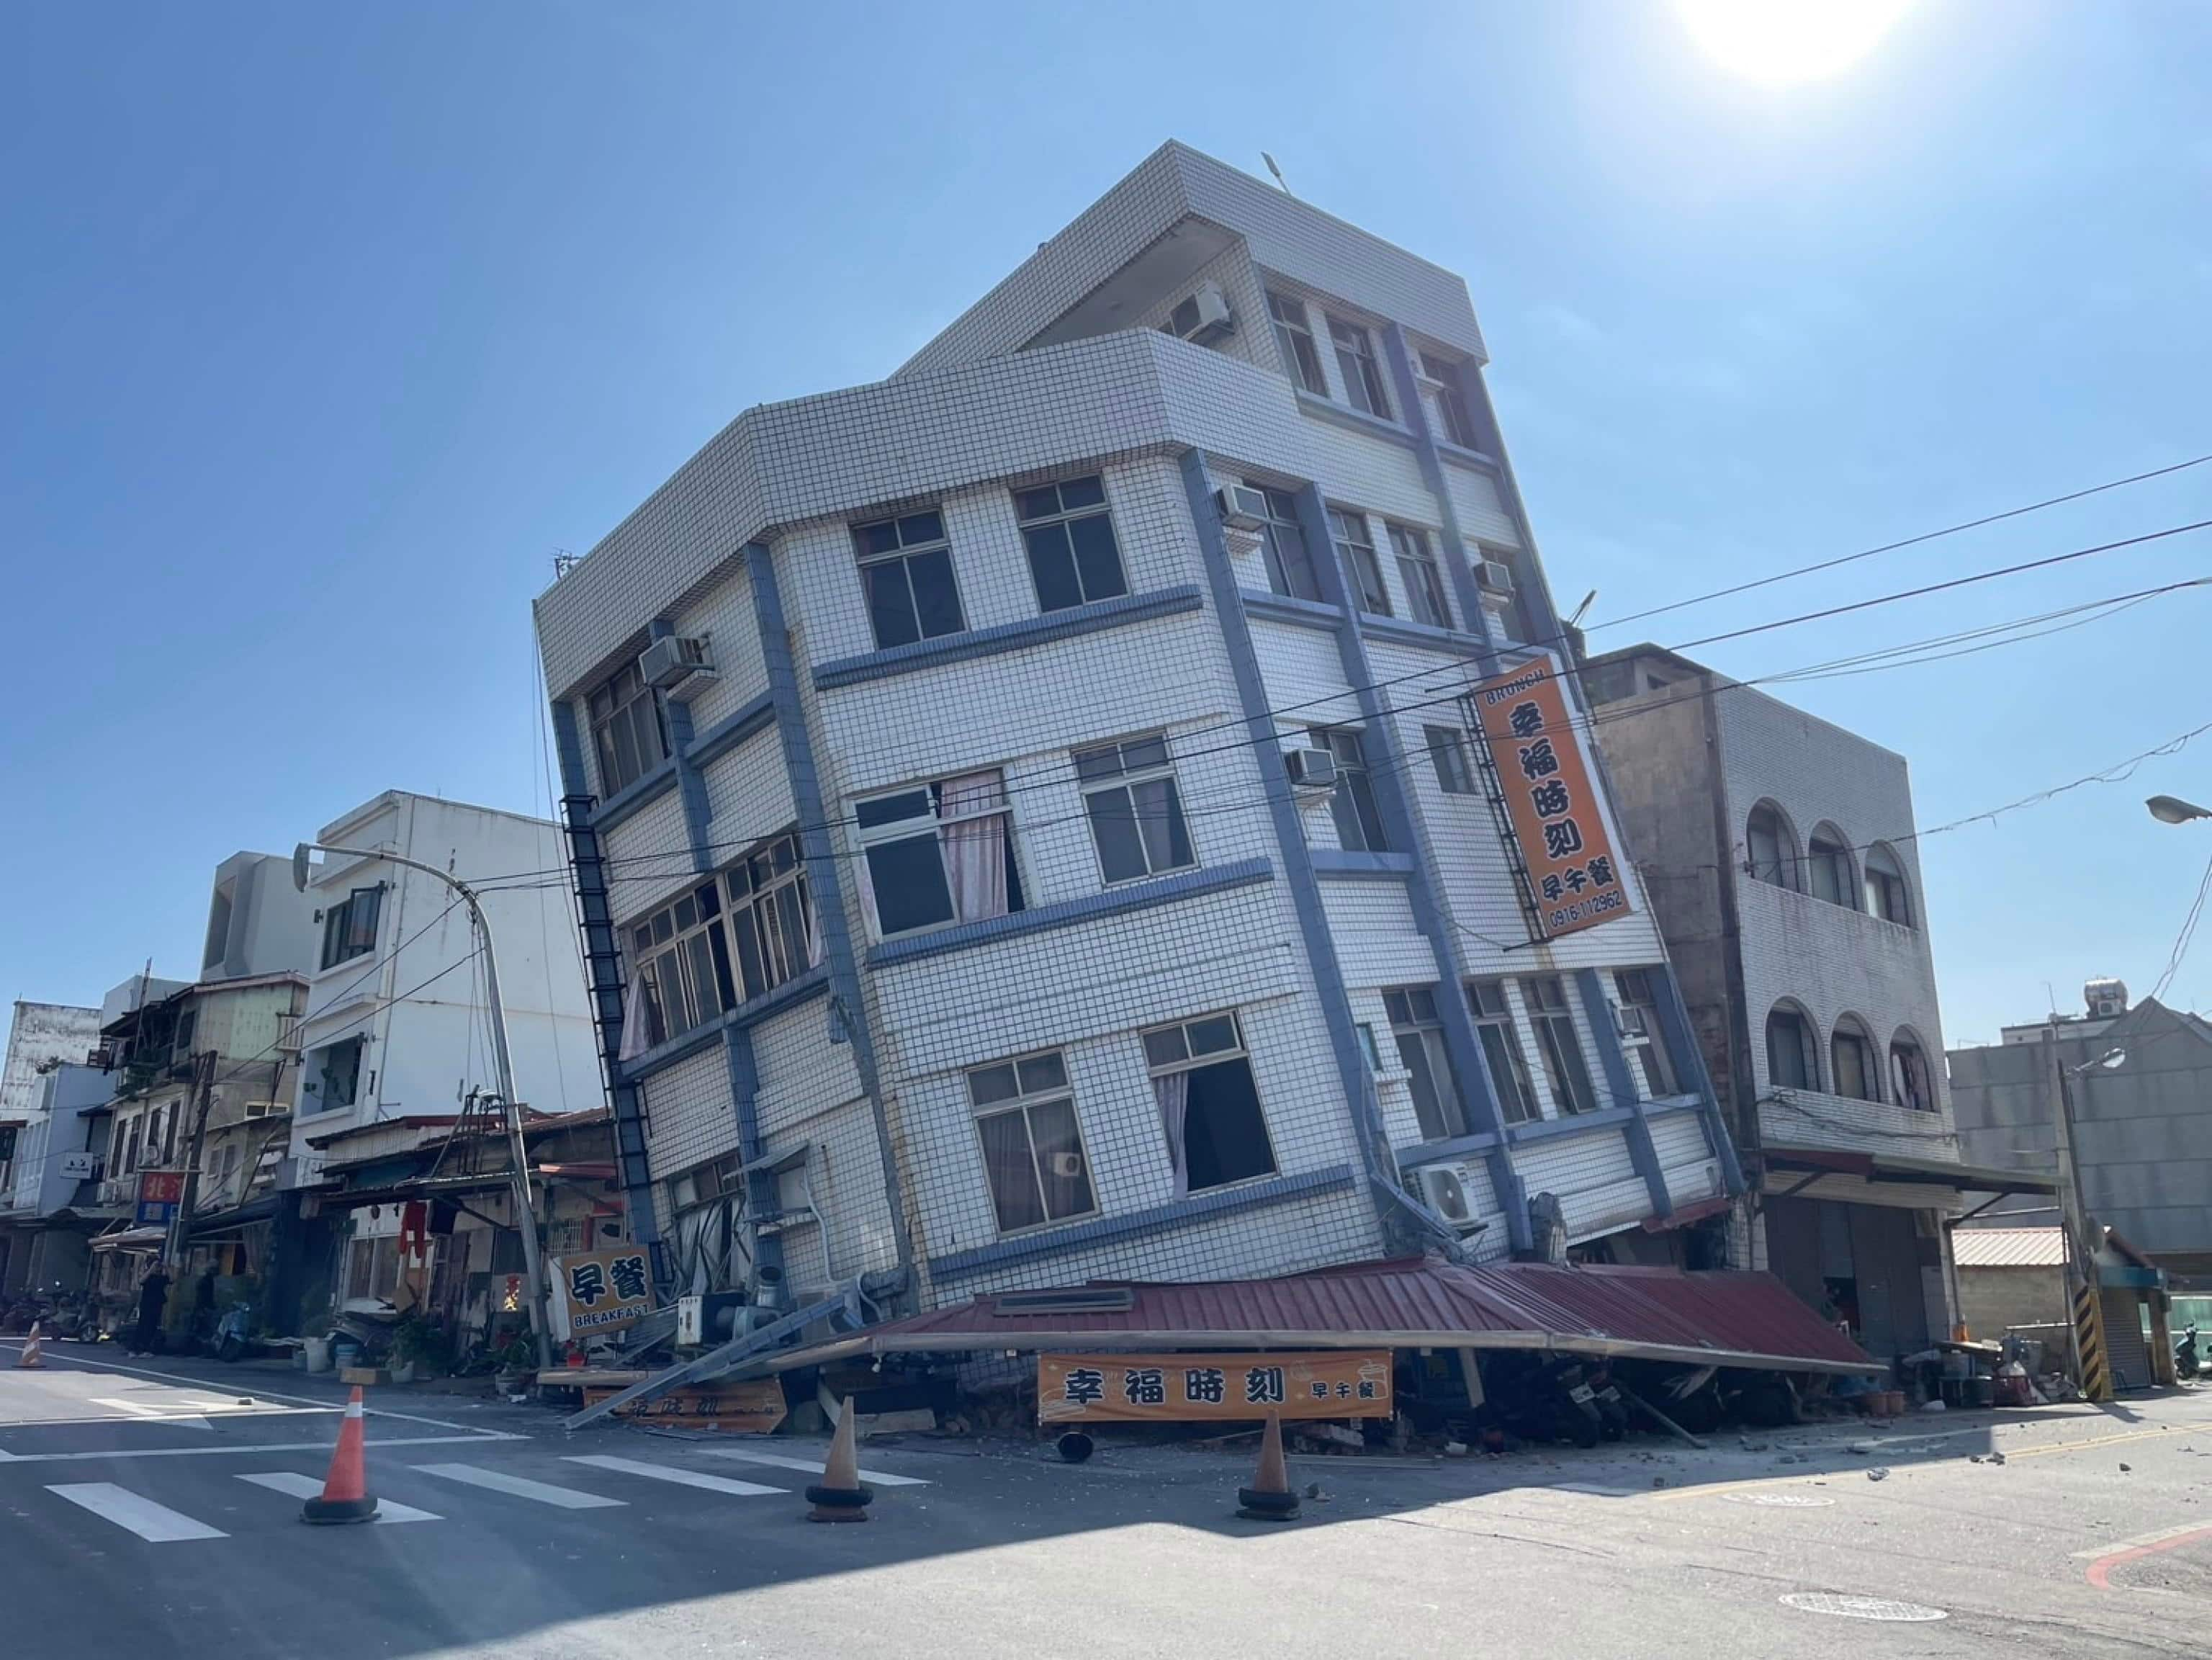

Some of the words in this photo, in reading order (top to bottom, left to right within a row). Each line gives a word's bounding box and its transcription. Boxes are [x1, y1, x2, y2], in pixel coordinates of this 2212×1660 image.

[1485, 668, 1545, 705] BRUNCH
[1509, 700, 1583, 858] 幸福時刻
[1541, 855, 1614, 901] 早午餐
[571, 1255, 647, 1306] 早餐
[575, 1304, 649, 1328] BREAKFAST
[1064, 1367, 1285, 1406] 幸福時刻
